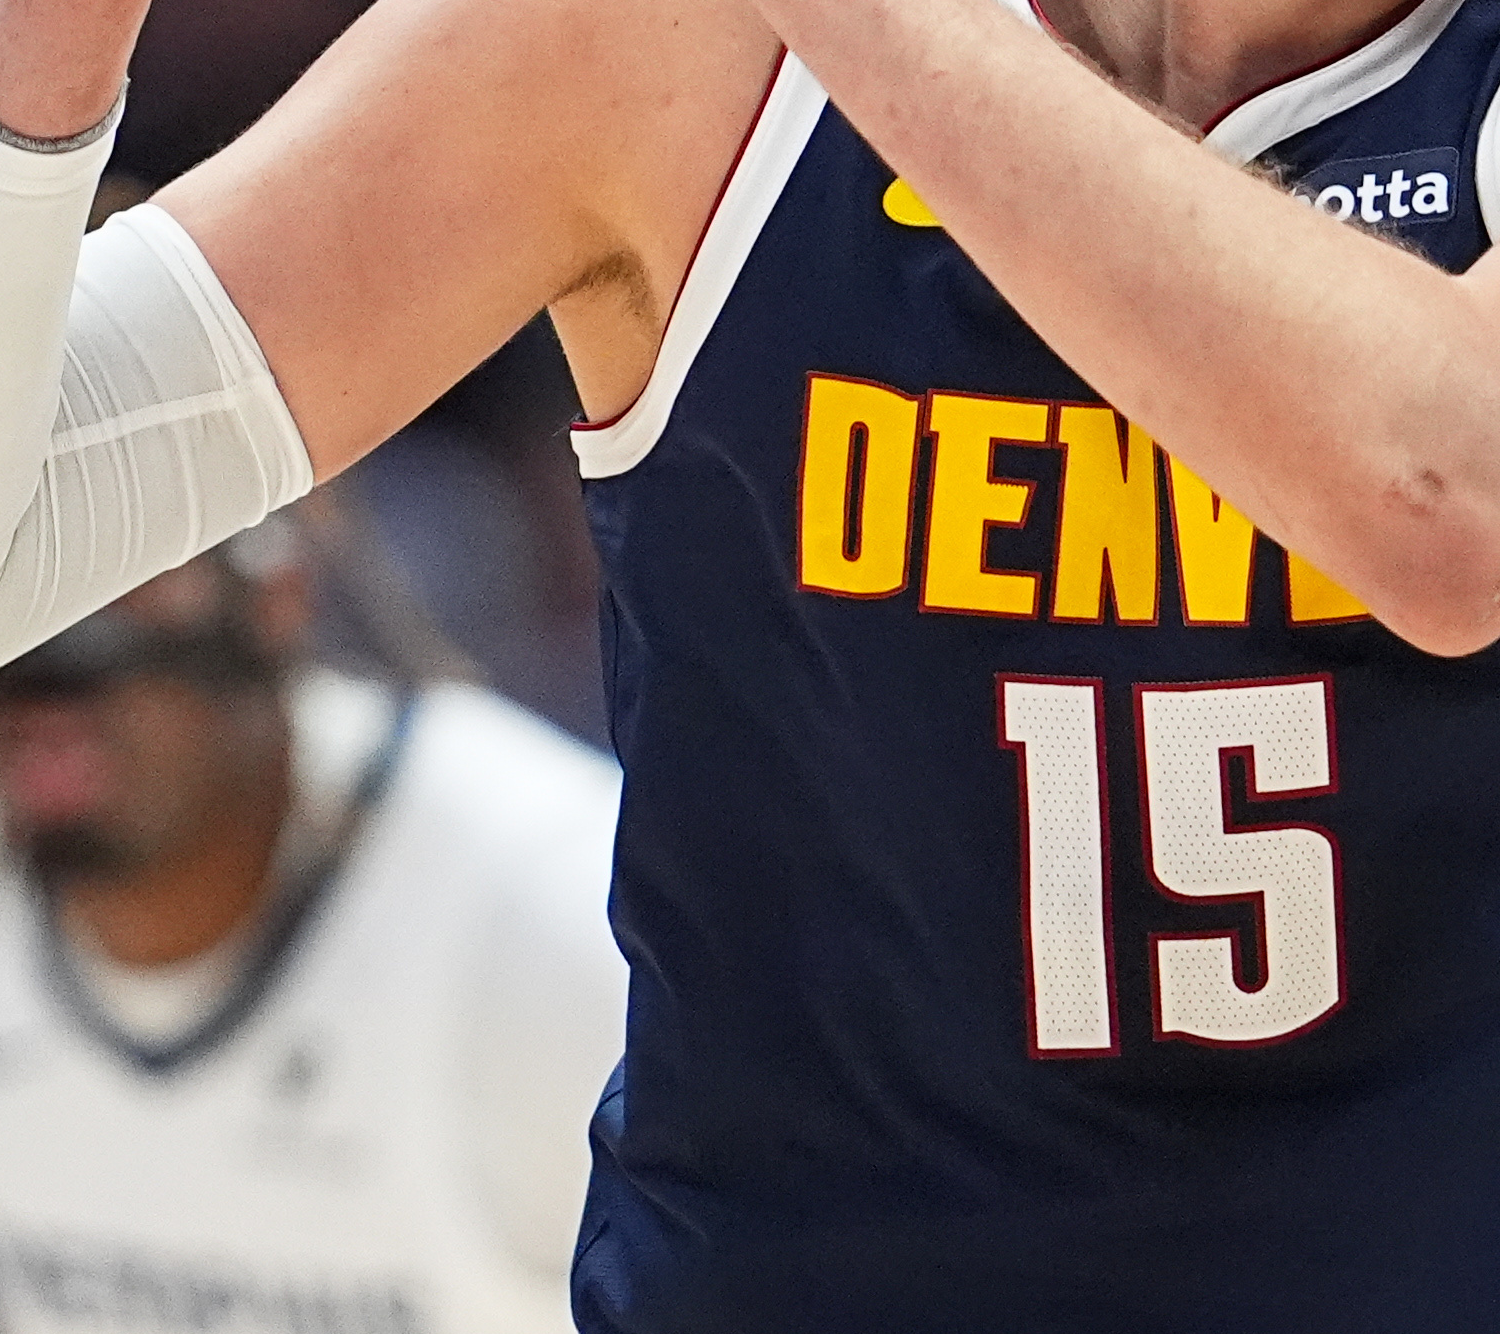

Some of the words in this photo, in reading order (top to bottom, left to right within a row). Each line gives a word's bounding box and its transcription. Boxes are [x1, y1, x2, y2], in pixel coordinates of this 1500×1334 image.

[1292, 169, 1450, 223] otta
[796, 370, 1374, 627] DENV
[994, 671, 1348, 1060] 15
